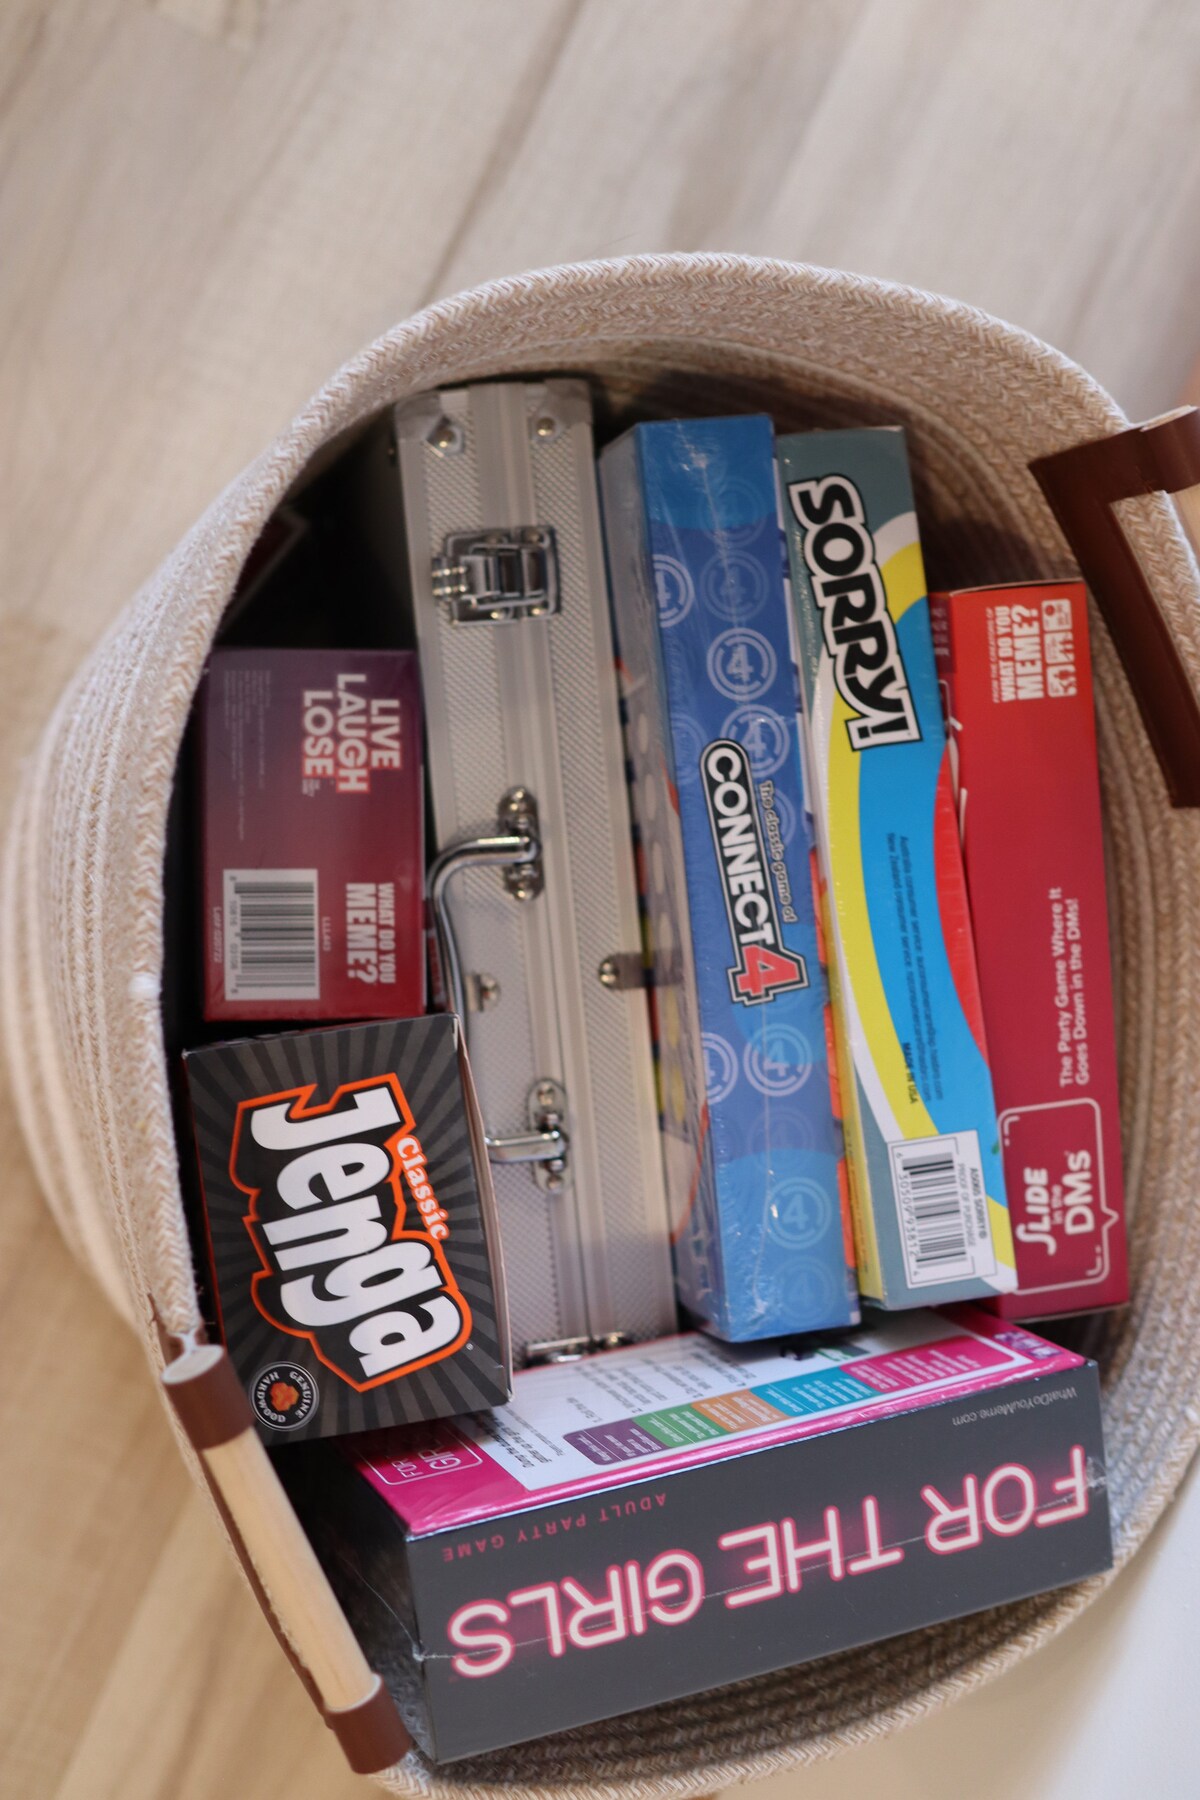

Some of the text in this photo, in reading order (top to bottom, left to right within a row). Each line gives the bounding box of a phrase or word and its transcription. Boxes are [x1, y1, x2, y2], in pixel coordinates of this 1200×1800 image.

[793, 478, 915, 745] SORRY!
[994, 605, 1014, 701] WHAT DO YOU
[1012, 604, 1043, 700] MEME?
[726, 643, 755, 683] 4
[304, 690, 333, 776] LOSE
[337, 674, 368, 792] LAUGH
[371, 699, 400, 768] LIVE
[706, 744, 806, 999] CONNECT 4
[758, 780, 798, 923] The classic game of
[346, 883, 377, 983] MEME?
[380, 883, 395, 983] WHAT DO YOU
[1048, 887, 1073, 1086] The Party Game Where It
[1064, 897, 1089, 1084] Goes Down in the DMs!
[901, 1041, 918, 1104] MADE IN USA
[396, 1135, 449, 1239] Classic
[899, 1173, 912, 1211] 30509
[957, 1163, 975, 1246] PROOF OF PURCHASE
[1012, 1166, 1056, 1256] SLIDE
[1049, 1183, 1063, 1224] in the
[1060, 1149, 1095, 1234] DMs
[250, 1086, 461, 1378] Jenga
[905, 1217, 919, 1257] 93812
[257, 1370, 286, 1424] HARDWOOD
[287, 1371, 310, 1420] GENUINE
[952, 1386, 1077, 1427] WhatDoYouMeme.com
[390, 1456, 421, 1479] FOR
[442, 1492, 667, 1561] ADULT PARTY GAME
[447, 1446, 1090, 1678] FOR THE GIRLS
